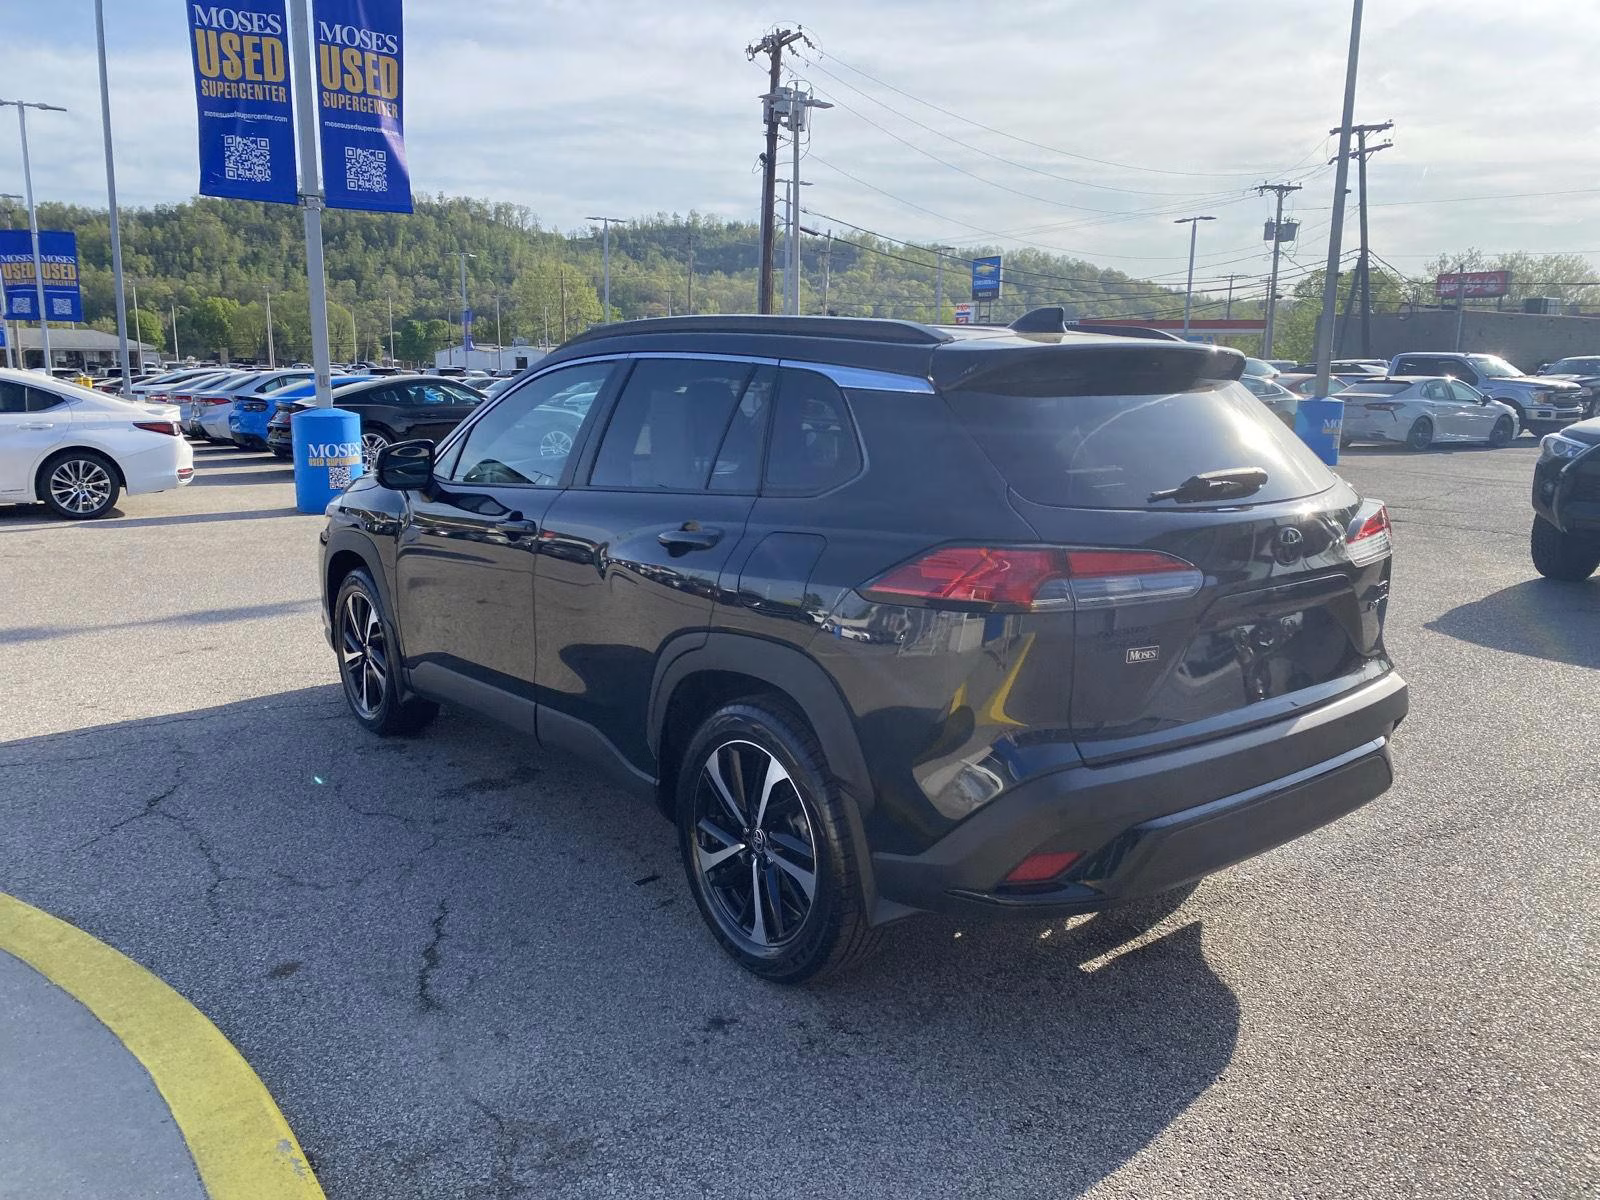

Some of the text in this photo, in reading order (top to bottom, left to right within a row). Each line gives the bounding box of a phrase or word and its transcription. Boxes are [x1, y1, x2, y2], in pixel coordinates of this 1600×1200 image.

[192, 4, 282, 35] MOSES
[318, 21, 398, 54] MOSES
[195, 29, 285, 82] USED
[319, 44, 398, 99] USED
[201, 79, 287, 103] SUPERCENTER
[0, 254, 34, 263] MOSES
[41, 255, 76, 264] MOSES
[1, 262, 35, 279] USED
[41, 262, 77, 280] USED
[1129, 650, 1156, 661] MOSES
